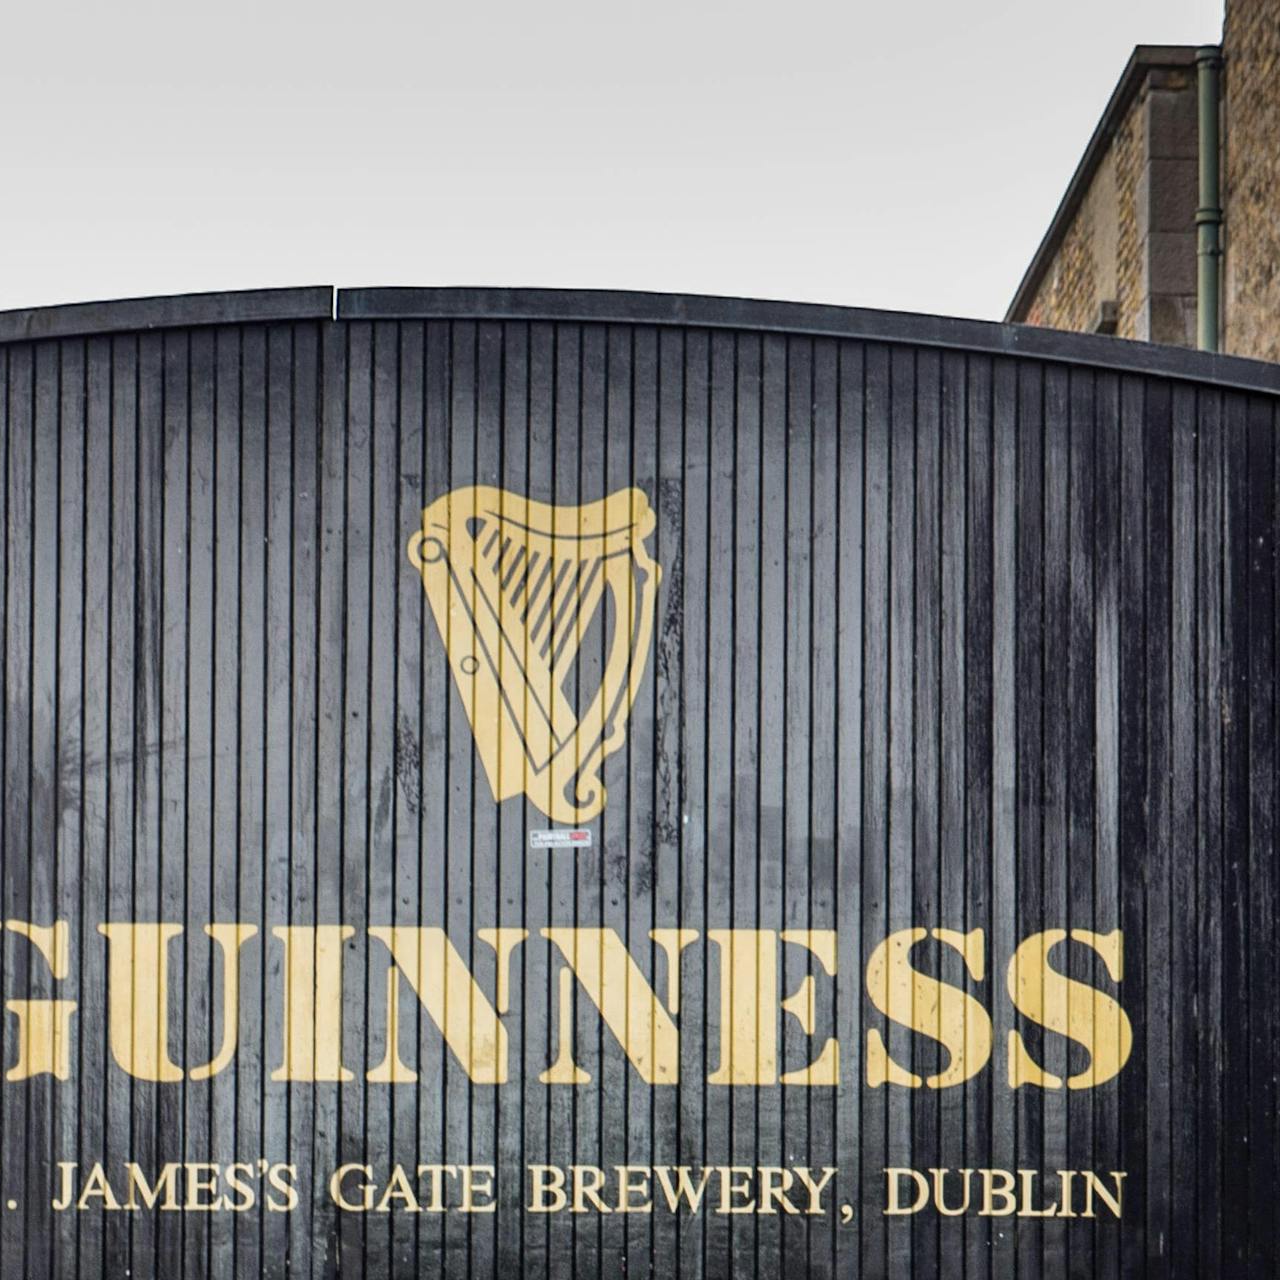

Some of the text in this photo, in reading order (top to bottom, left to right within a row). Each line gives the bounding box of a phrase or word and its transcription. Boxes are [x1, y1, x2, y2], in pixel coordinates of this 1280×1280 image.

[52, 1159, 298, 1214] JAMES'S
[329, 1163, 497, 1215] GATE
[528, 1165, 854, 1222] BREWERY,
[884, 1167, 1129, 1220] DUBLIN
